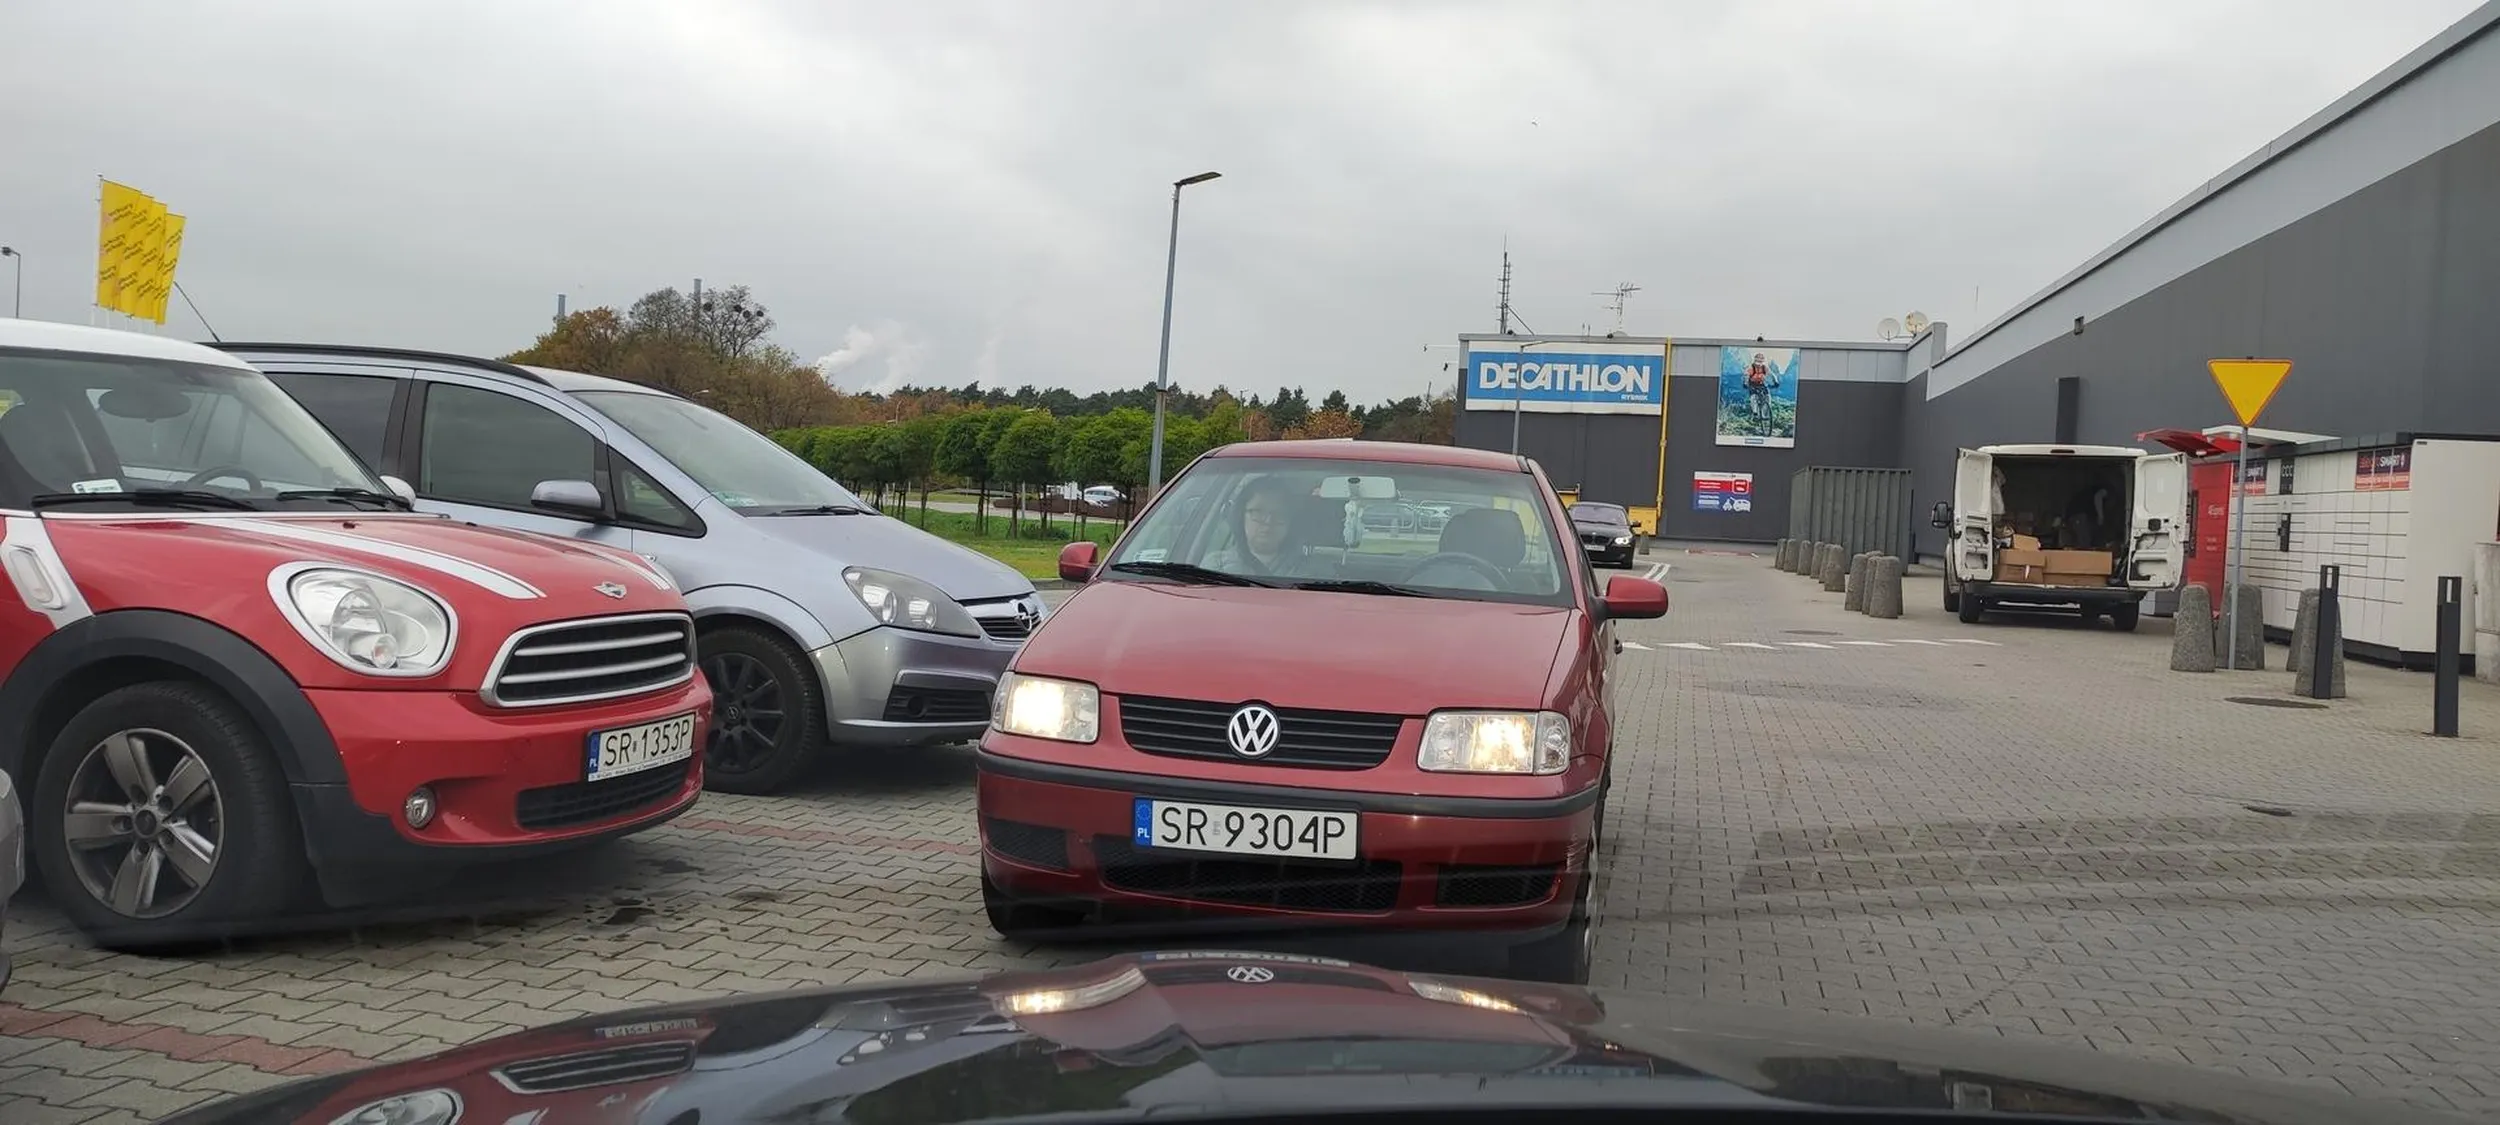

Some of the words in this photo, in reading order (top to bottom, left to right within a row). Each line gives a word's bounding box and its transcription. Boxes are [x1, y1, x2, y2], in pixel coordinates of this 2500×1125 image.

[1479, 361, 1651, 393] DECATHLON
[604, 733, 632, 767] SR
[641, 719, 690, 760] 1353P
[589, 759, 598, 768] PL
[1137, 828, 1150, 839] PL
[1161, 806, 1208, 846] SR
[1224, 810, 1346, 854] 9304P
